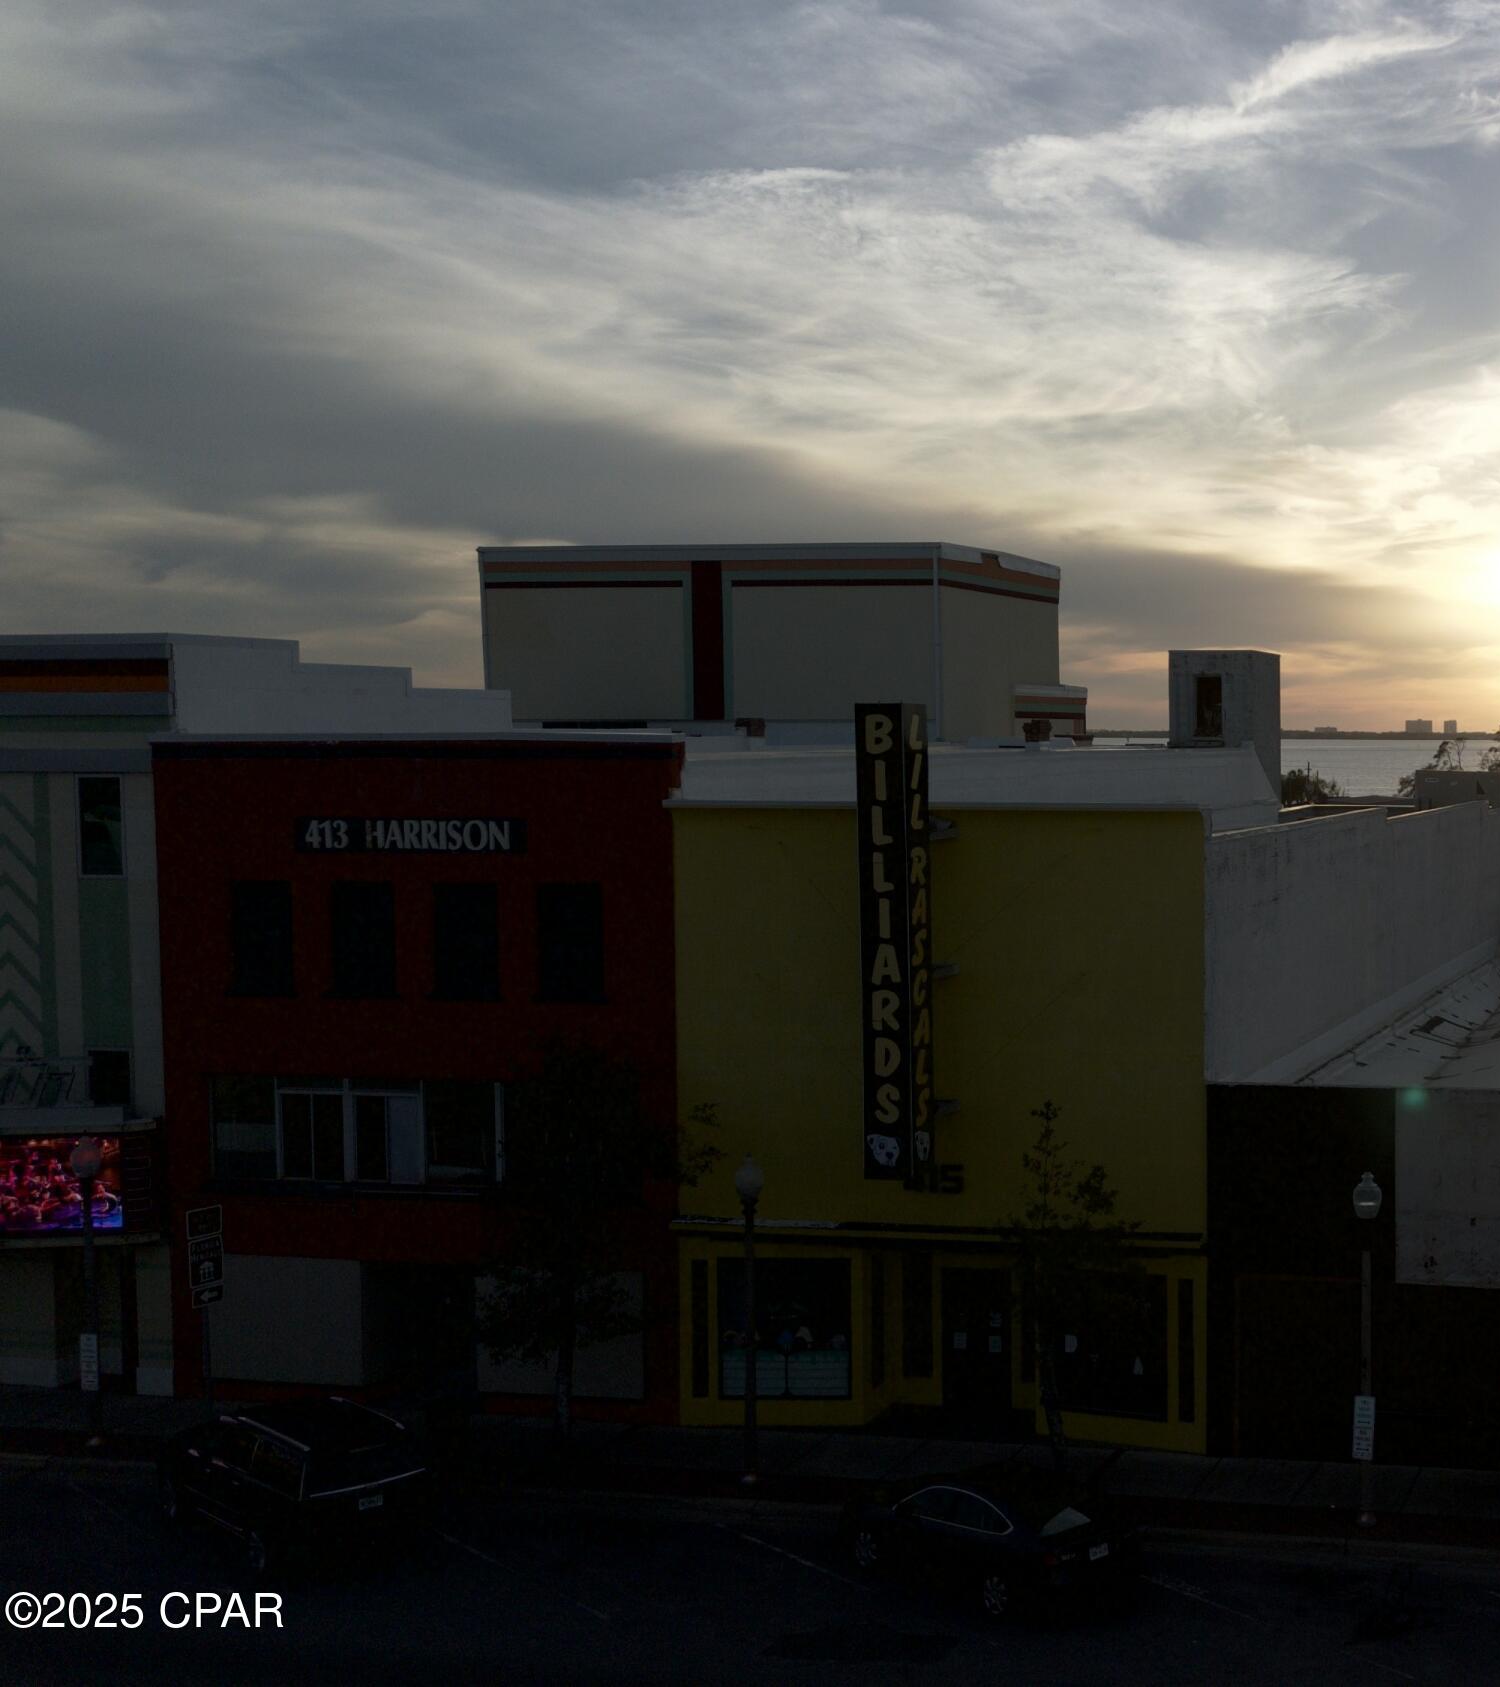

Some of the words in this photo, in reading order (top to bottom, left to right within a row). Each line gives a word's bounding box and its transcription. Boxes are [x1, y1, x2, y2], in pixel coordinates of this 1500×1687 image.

[304, 819, 350, 849] 413
[365, 819, 512, 851] HARRISON
[909, 713, 925, 830] LIL
[864, 714, 902, 1125] BILLIARDS
[910, 847, 931, 1127] RASCALS
